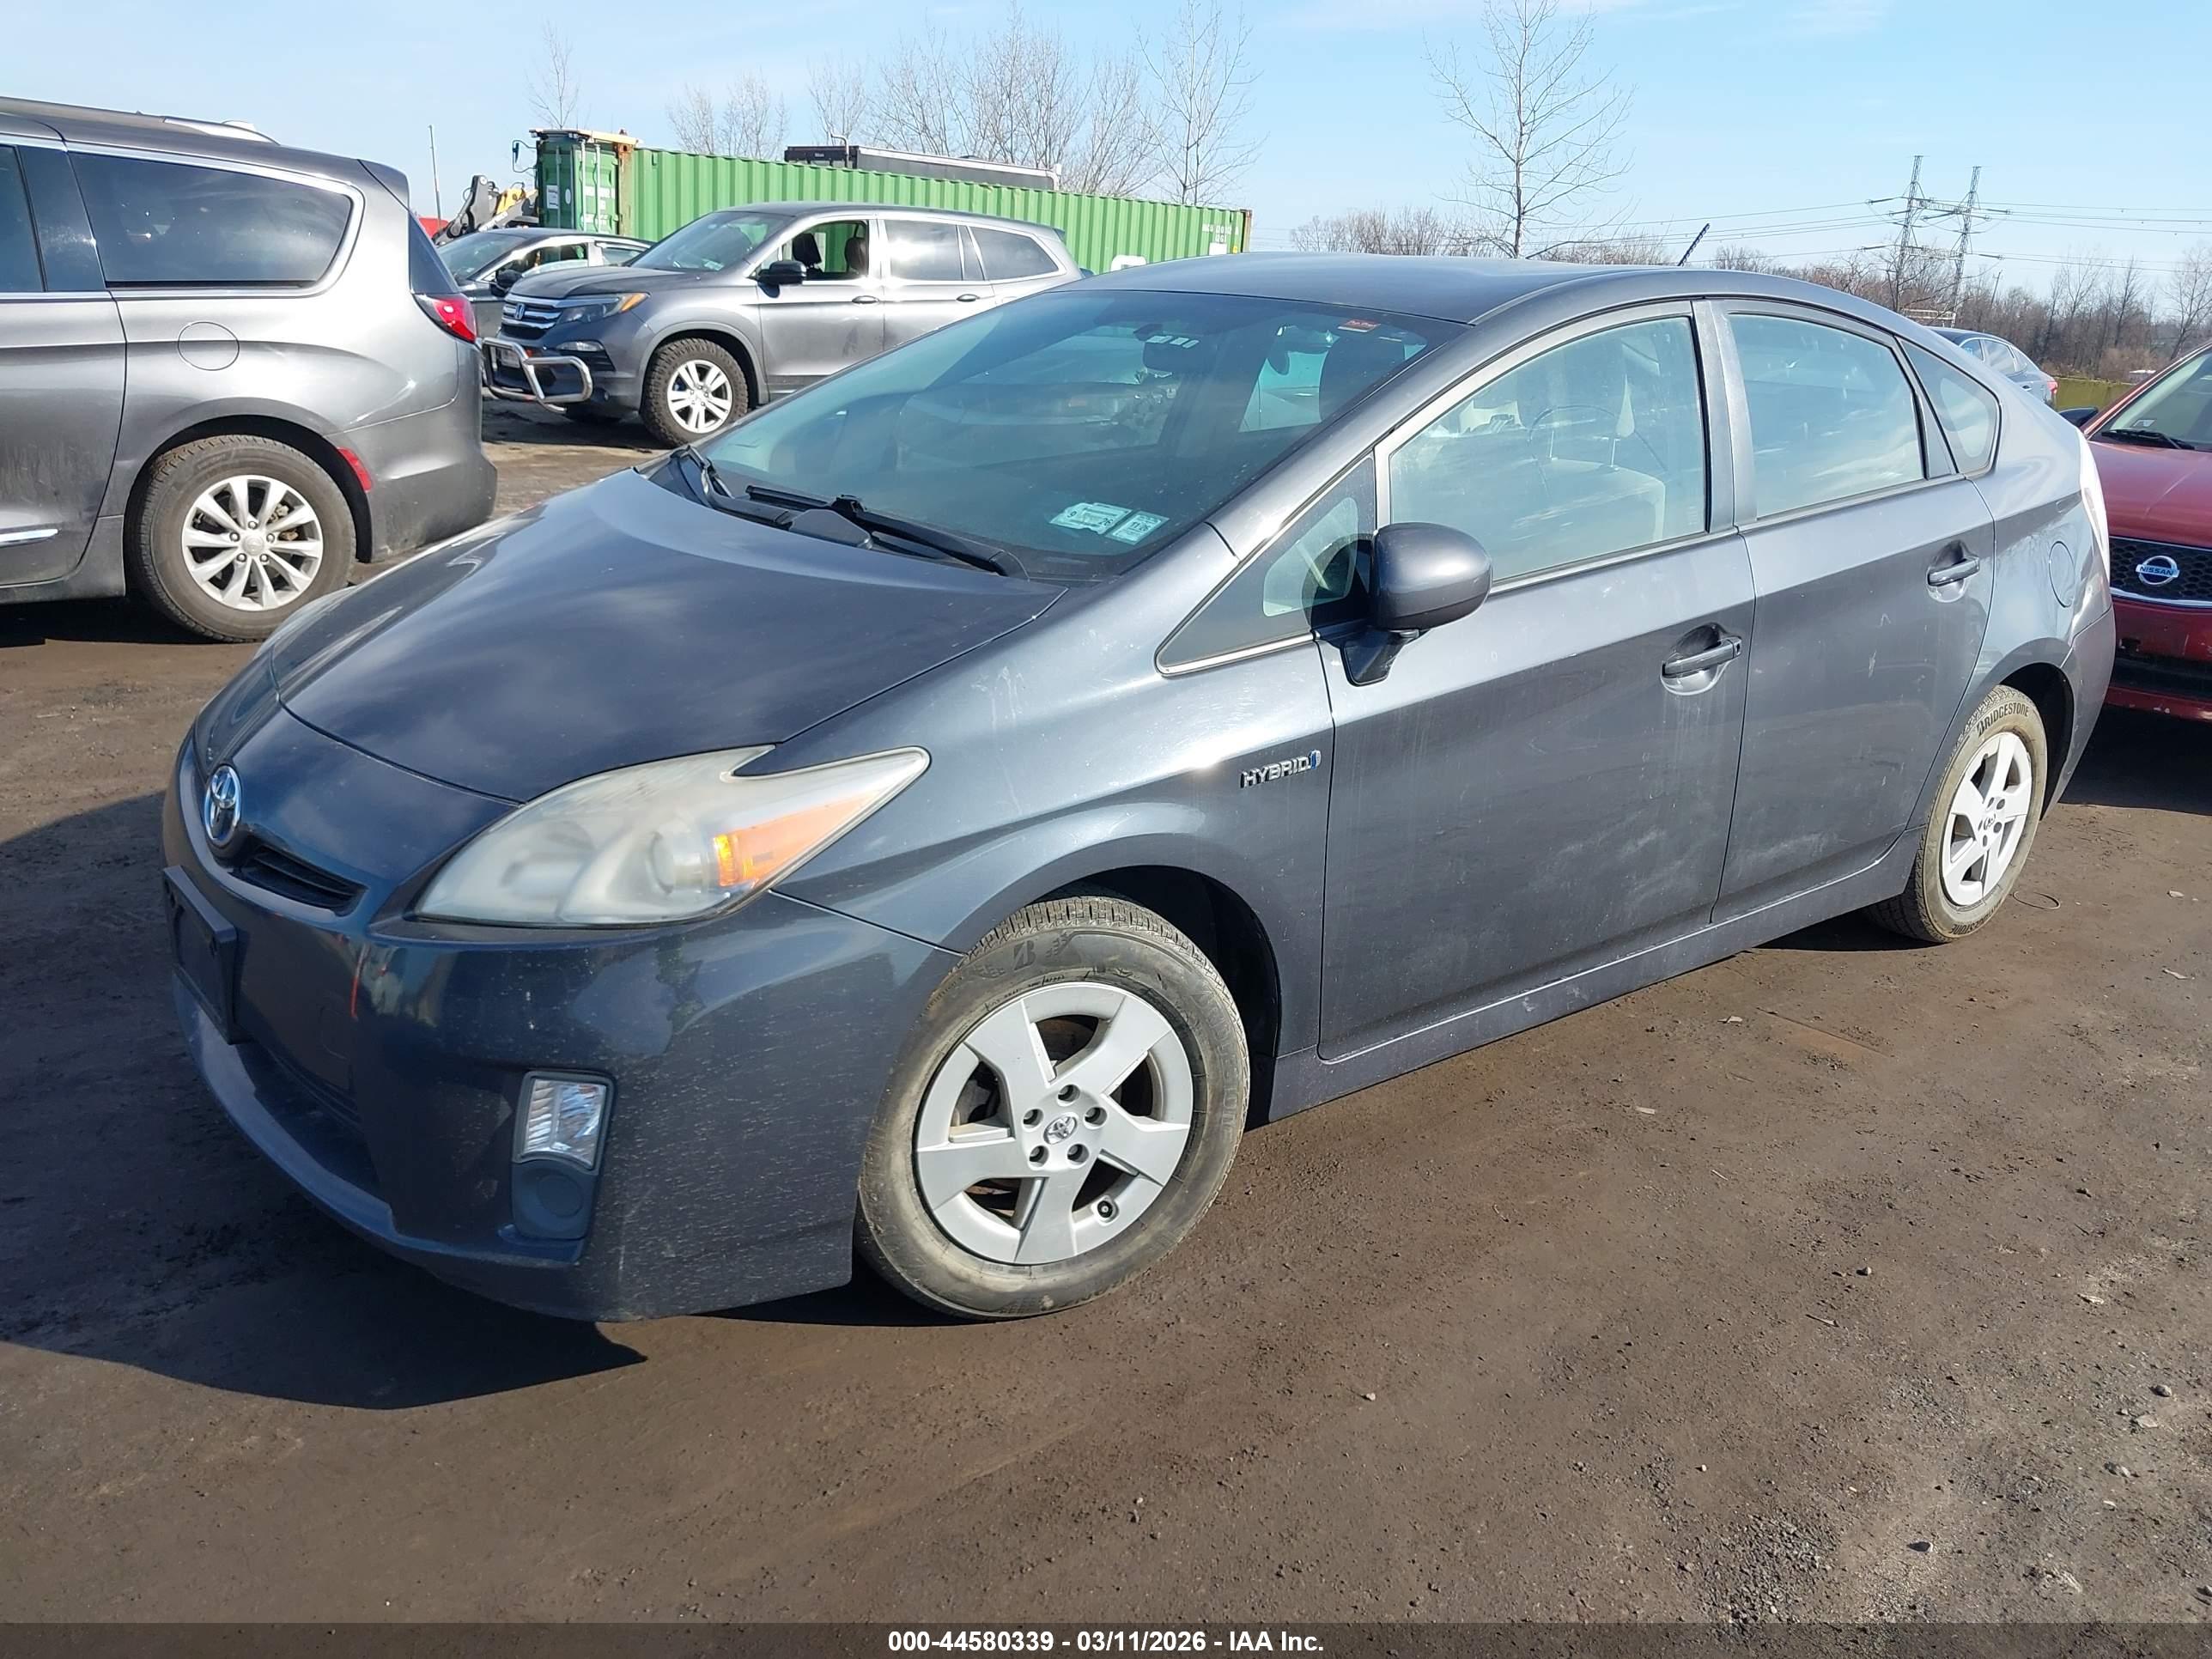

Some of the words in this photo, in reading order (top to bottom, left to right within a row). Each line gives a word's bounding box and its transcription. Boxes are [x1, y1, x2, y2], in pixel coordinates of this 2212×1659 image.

[2139, 565, 2173, 576] NISSAN
[1976, 702, 2029, 738] BRIDGESTONE
[1240, 756, 1312, 788] HYBRID
